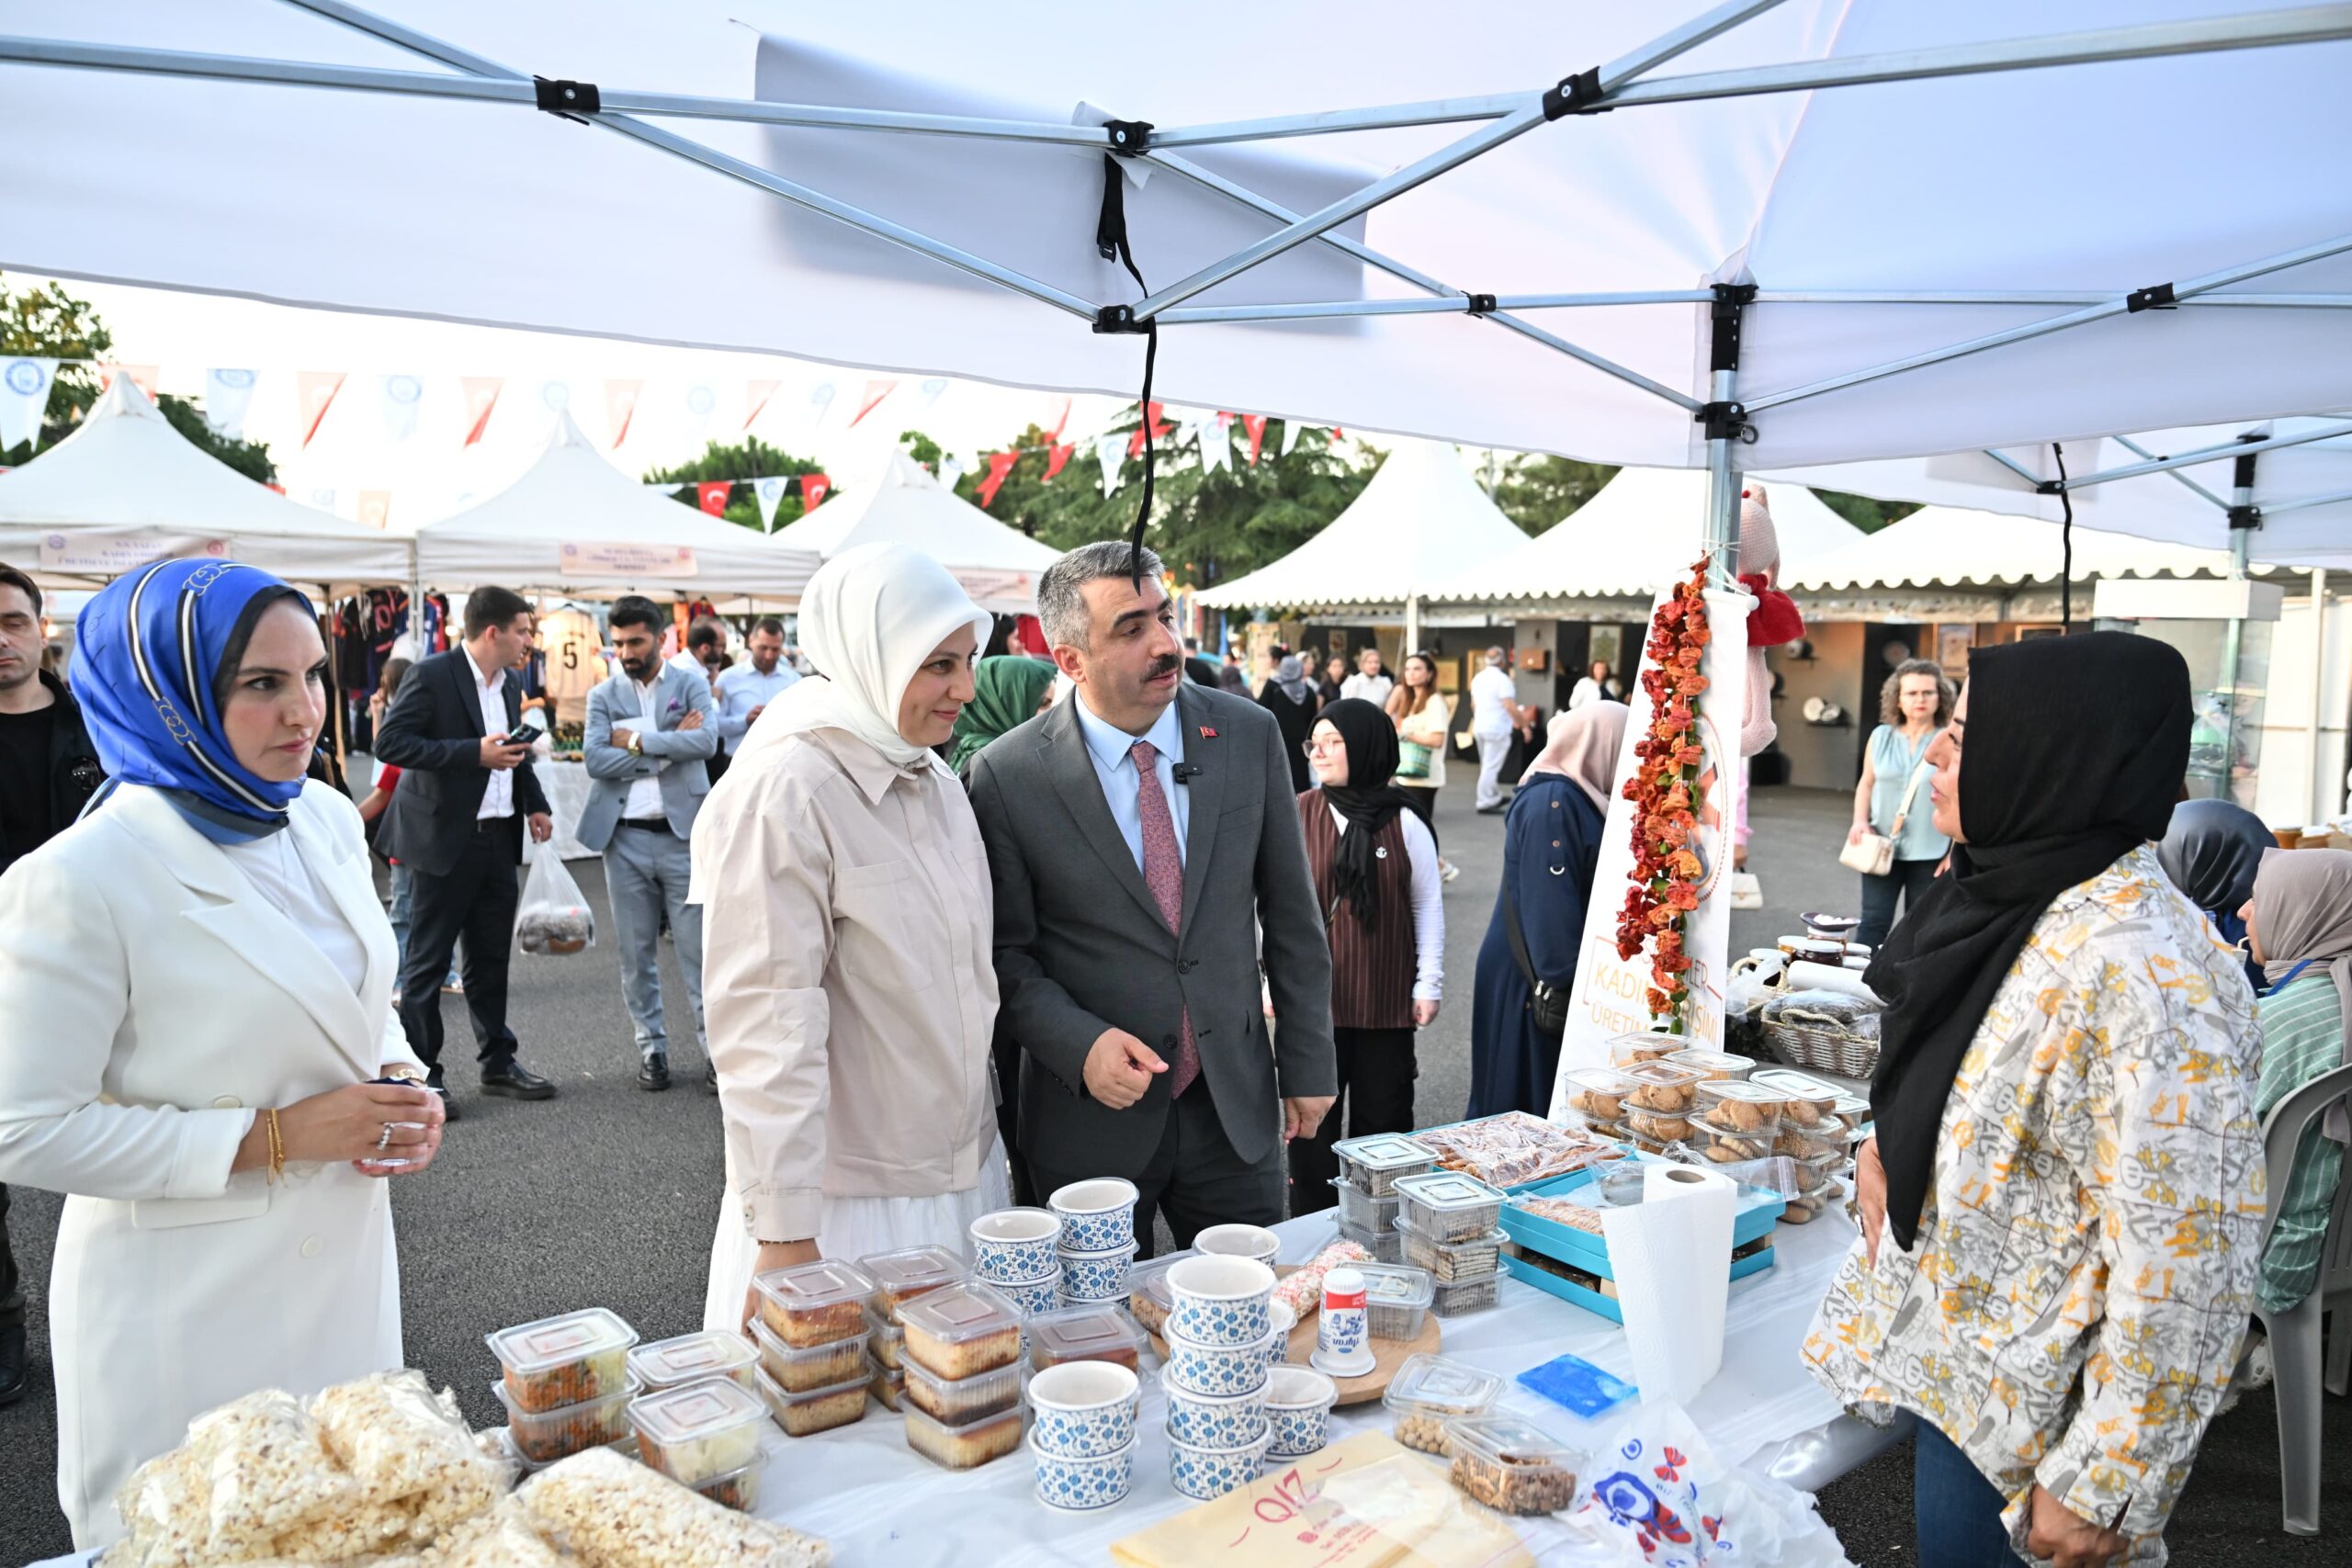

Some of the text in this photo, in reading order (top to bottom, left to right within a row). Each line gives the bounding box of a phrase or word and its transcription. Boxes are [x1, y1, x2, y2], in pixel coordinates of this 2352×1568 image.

[563, 641, 578, 670] 5
[1681, 997, 1718, 1047] RİŞİMİ
[1332, 1337, 1361, 1348] Ayran
